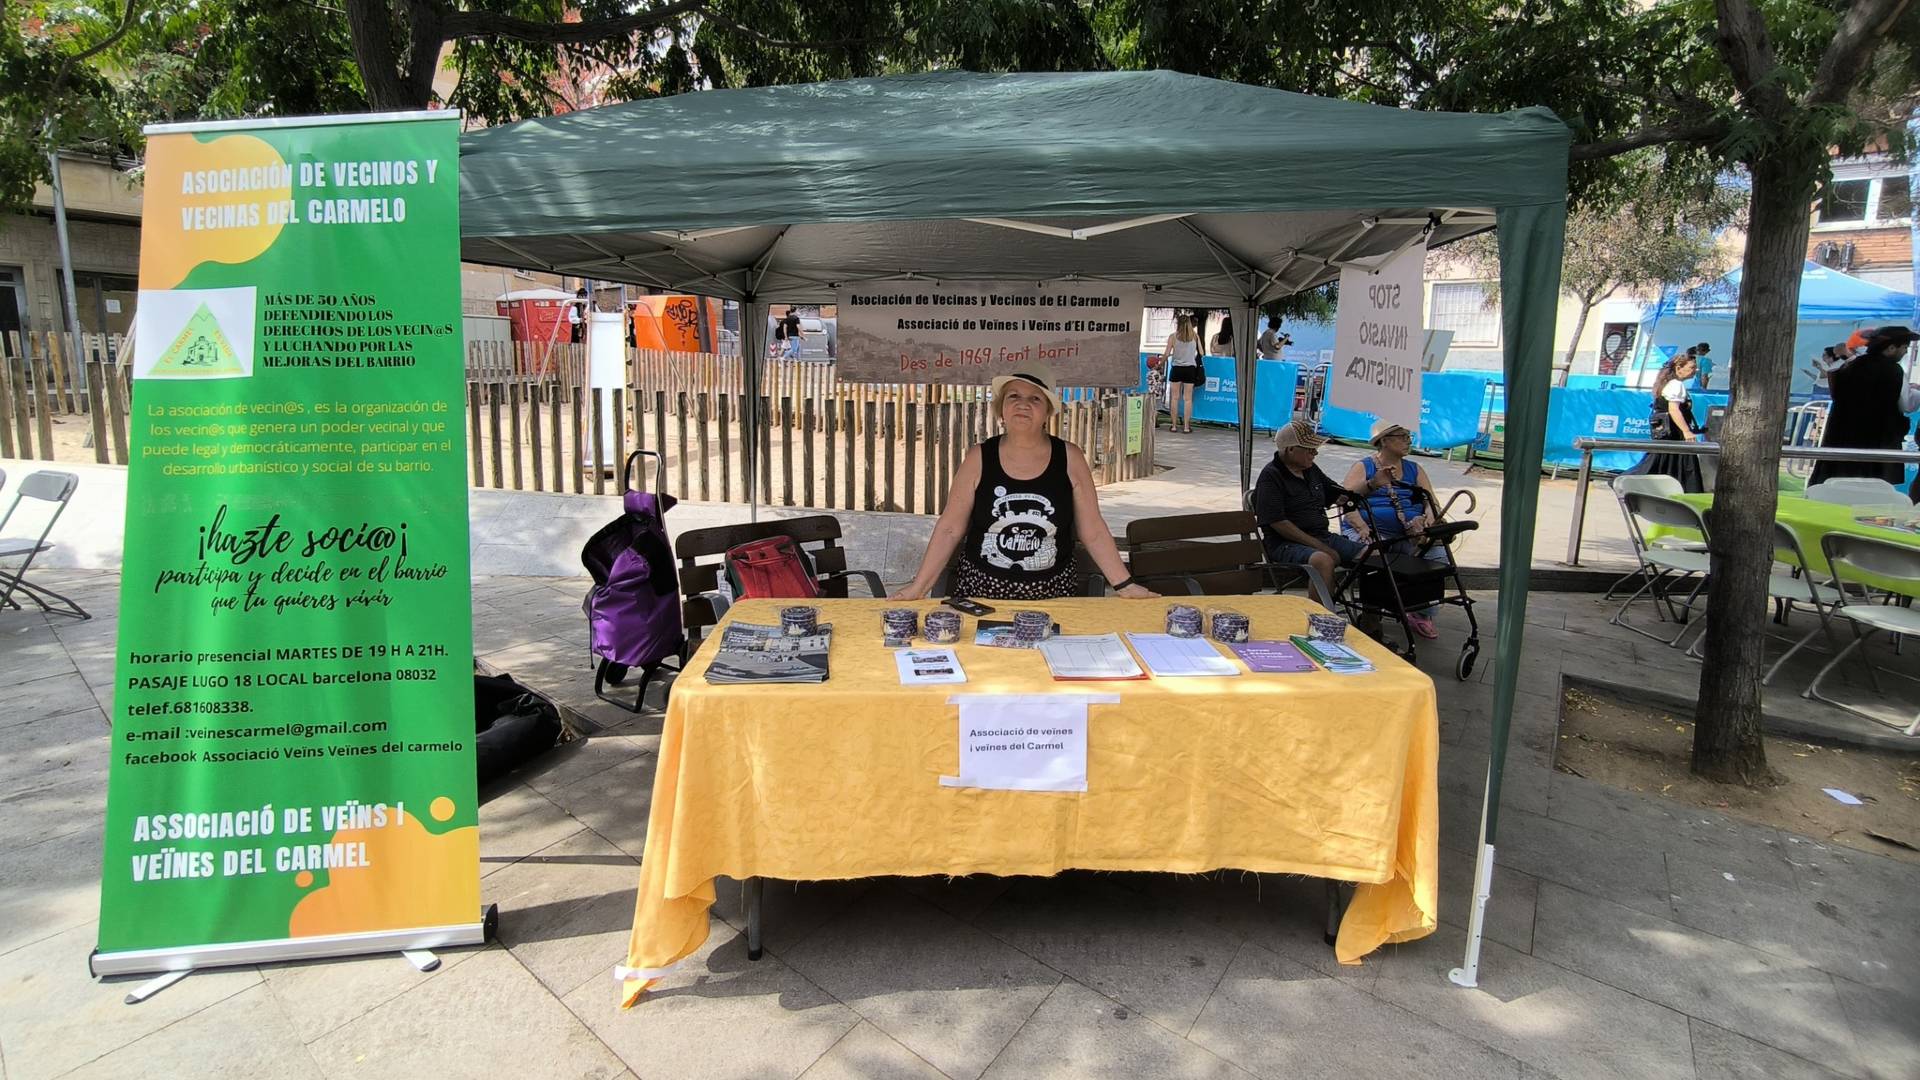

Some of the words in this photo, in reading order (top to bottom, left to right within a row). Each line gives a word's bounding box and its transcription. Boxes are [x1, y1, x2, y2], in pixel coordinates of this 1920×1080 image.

[182, 162, 292, 194] ASOCIACIÓN
[301, 162, 326, 187] DE
[334, 160, 418, 187] VECINOS
[427, 160, 438, 183] Y
[182, 206, 260, 230] VECINAS
[268, 201, 299, 225] DEL
[308, 198, 406, 222] CARMELO
[264, 292, 293, 306] MÁS
[296, 294, 314, 305] DE
[319, 295, 335, 305] 50
[340, 292, 376, 306] AÑOS
[851, 293, 912, 306] Asociación
[916, 295, 929, 306] de
[933, 294, 978, 306] Vecinas
[981, 297, 987, 308] y
[990, 295, 1036, 306] Vecinos
[1040, 295, 1054, 307] de
[1057, 295, 1068, 307] El
[1070, 295, 1120, 307] Carmelo
[264, 310, 364, 322] DEFENDIENDO
[368, 309, 393, 321] LOS
[264, 325, 343, 337] DERECHOS
[347, 325, 365, 336] DE
[367, 324, 392, 336] LOS
[395, 323, 453, 337] VECIN@S
[898, 318, 959, 330] Associació
[963, 319, 976, 330] de
[980, 319, 1019, 331] Veïnes
[1022, 319, 1026, 331] i
[1029, 319, 1061, 331] Veïns
[1064, 320, 1085, 332] d'El
[1088, 320, 1130, 332] Carmel
[263, 341, 271, 351] Y
[273, 341, 358, 352] LUCHANDO
[360, 340, 386, 352] POR
[388, 340, 413, 351] LAS
[262, 356, 331, 368] MEJORAS
[335, 356, 364, 368] DEL
[366, 355, 416, 367] BARRIO
[900, 354, 927, 371] Des
[935, 352, 952, 368] de
[960, 347, 991, 365] 1969
[999, 345, 1030, 362] fent
[1038, 344, 1079, 359] barri
[148, 406, 164, 416] La
[169, 404, 233, 416] asociación
[234, 403, 248, 414] de
[315, 403, 330, 413] es
[335, 401, 347, 413] la
[352, 400, 428, 416] organización
[432, 400, 448, 412] de
[151, 424, 171, 436] los
[175, 424, 225, 436] vecin@s
[228, 425, 247, 438] que
[251, 423, 297, 437] genera
[301, 423, 317, 433] un
[321, 421, 364, 436] poder
[369, 421, 408, 432] vecinal
[409, 422, 418, 435] y
[422, 422, 445, 435] que
[1623, 418, 1650, 428] Aigü
[143, 443, 189, 458] puede
[193, 442, 221, 458] legal
[221, 443, 229, 457] y
[231, 441, 356, 456] democráticamente,
[361, 440, 418, 455] participar
[422, 441, 437, 451] en
[441, 439, 451, 451] el
[163, 463, 226, 477] desarrollo
[229, 461, 299, 475] urbanístico
[302, 462, 309, 476] y
[312, 461, 352, 473] social
[356, 461, 373, 472] de
[378, 462, 392, 472] su
[395, 460, 434, 472] barrio.
[155, 561, 243, 593] participa
[248, 566, 265, 589] y
[271, 560, 334, 584] decide
[339, 566, 361, 580] en
[368, 556, 392, 582] el
[394, 555, 448, 581] barrio
[211, 595, 238, 616] que
[244, 588, 267, 612] tu
[273, 591, 340, 614] quieres
[345, 588, 394, 607] vivir
[130, 650, 193, 665] horario
[197, 649, 271, 666] presencial
[276, 647, 337, 662] MARTES
[342, 646, 363, 659] DE
[368, 645, 386, 658] 19
[391, 645, 400, 657] H
[405, 645, 414, 656] A
[418, 644, 449, 657] 21H.
[128, 675, 188, 690] PASAJE
[192, 674, 229, 688] LUGO
[234, 674, 252, 688] 18
[257, 672, 308, 687] LOCAL
[313, 670, 392, 685] barcelona
[396, 669, 436, 681] 08032
[128, 701, 254, 717] telef.681608338.
[126, 727, 180, 743] e-mail
[185, 719, 387, 742] :veinescarmel@gmail.com
[970, 726, 1024, 737] Associació
[1027, 728, 1039, 736] de
[1041, 727, 1073, 736] veïnes
[125, 749, 197, 766] facebook
[202, 747, 279, 763] Associació
[284, 745, 324, 759] Veïns
[328, 743, 378, 758] Veïnes
[381, 741, 403, 754] del
[408, 740, 463, 753] carmelo
[975, 743, 1007, 752] veïnes
[1010, 742, 1025, 750] del
[1028, 742, 1064, 750] Carmel
[133, 804, 275, 842] ASSOCIACIÓ
[284, 807, 312, 833] DE
[322, 800, 387, 831] VEÏNS
[397, 802, 404, 826] I
[132, 847, 215, 882] VEÏNES
[223, 848, 267, 876] DEL
[276, 842, 370, 872] CARMEL
